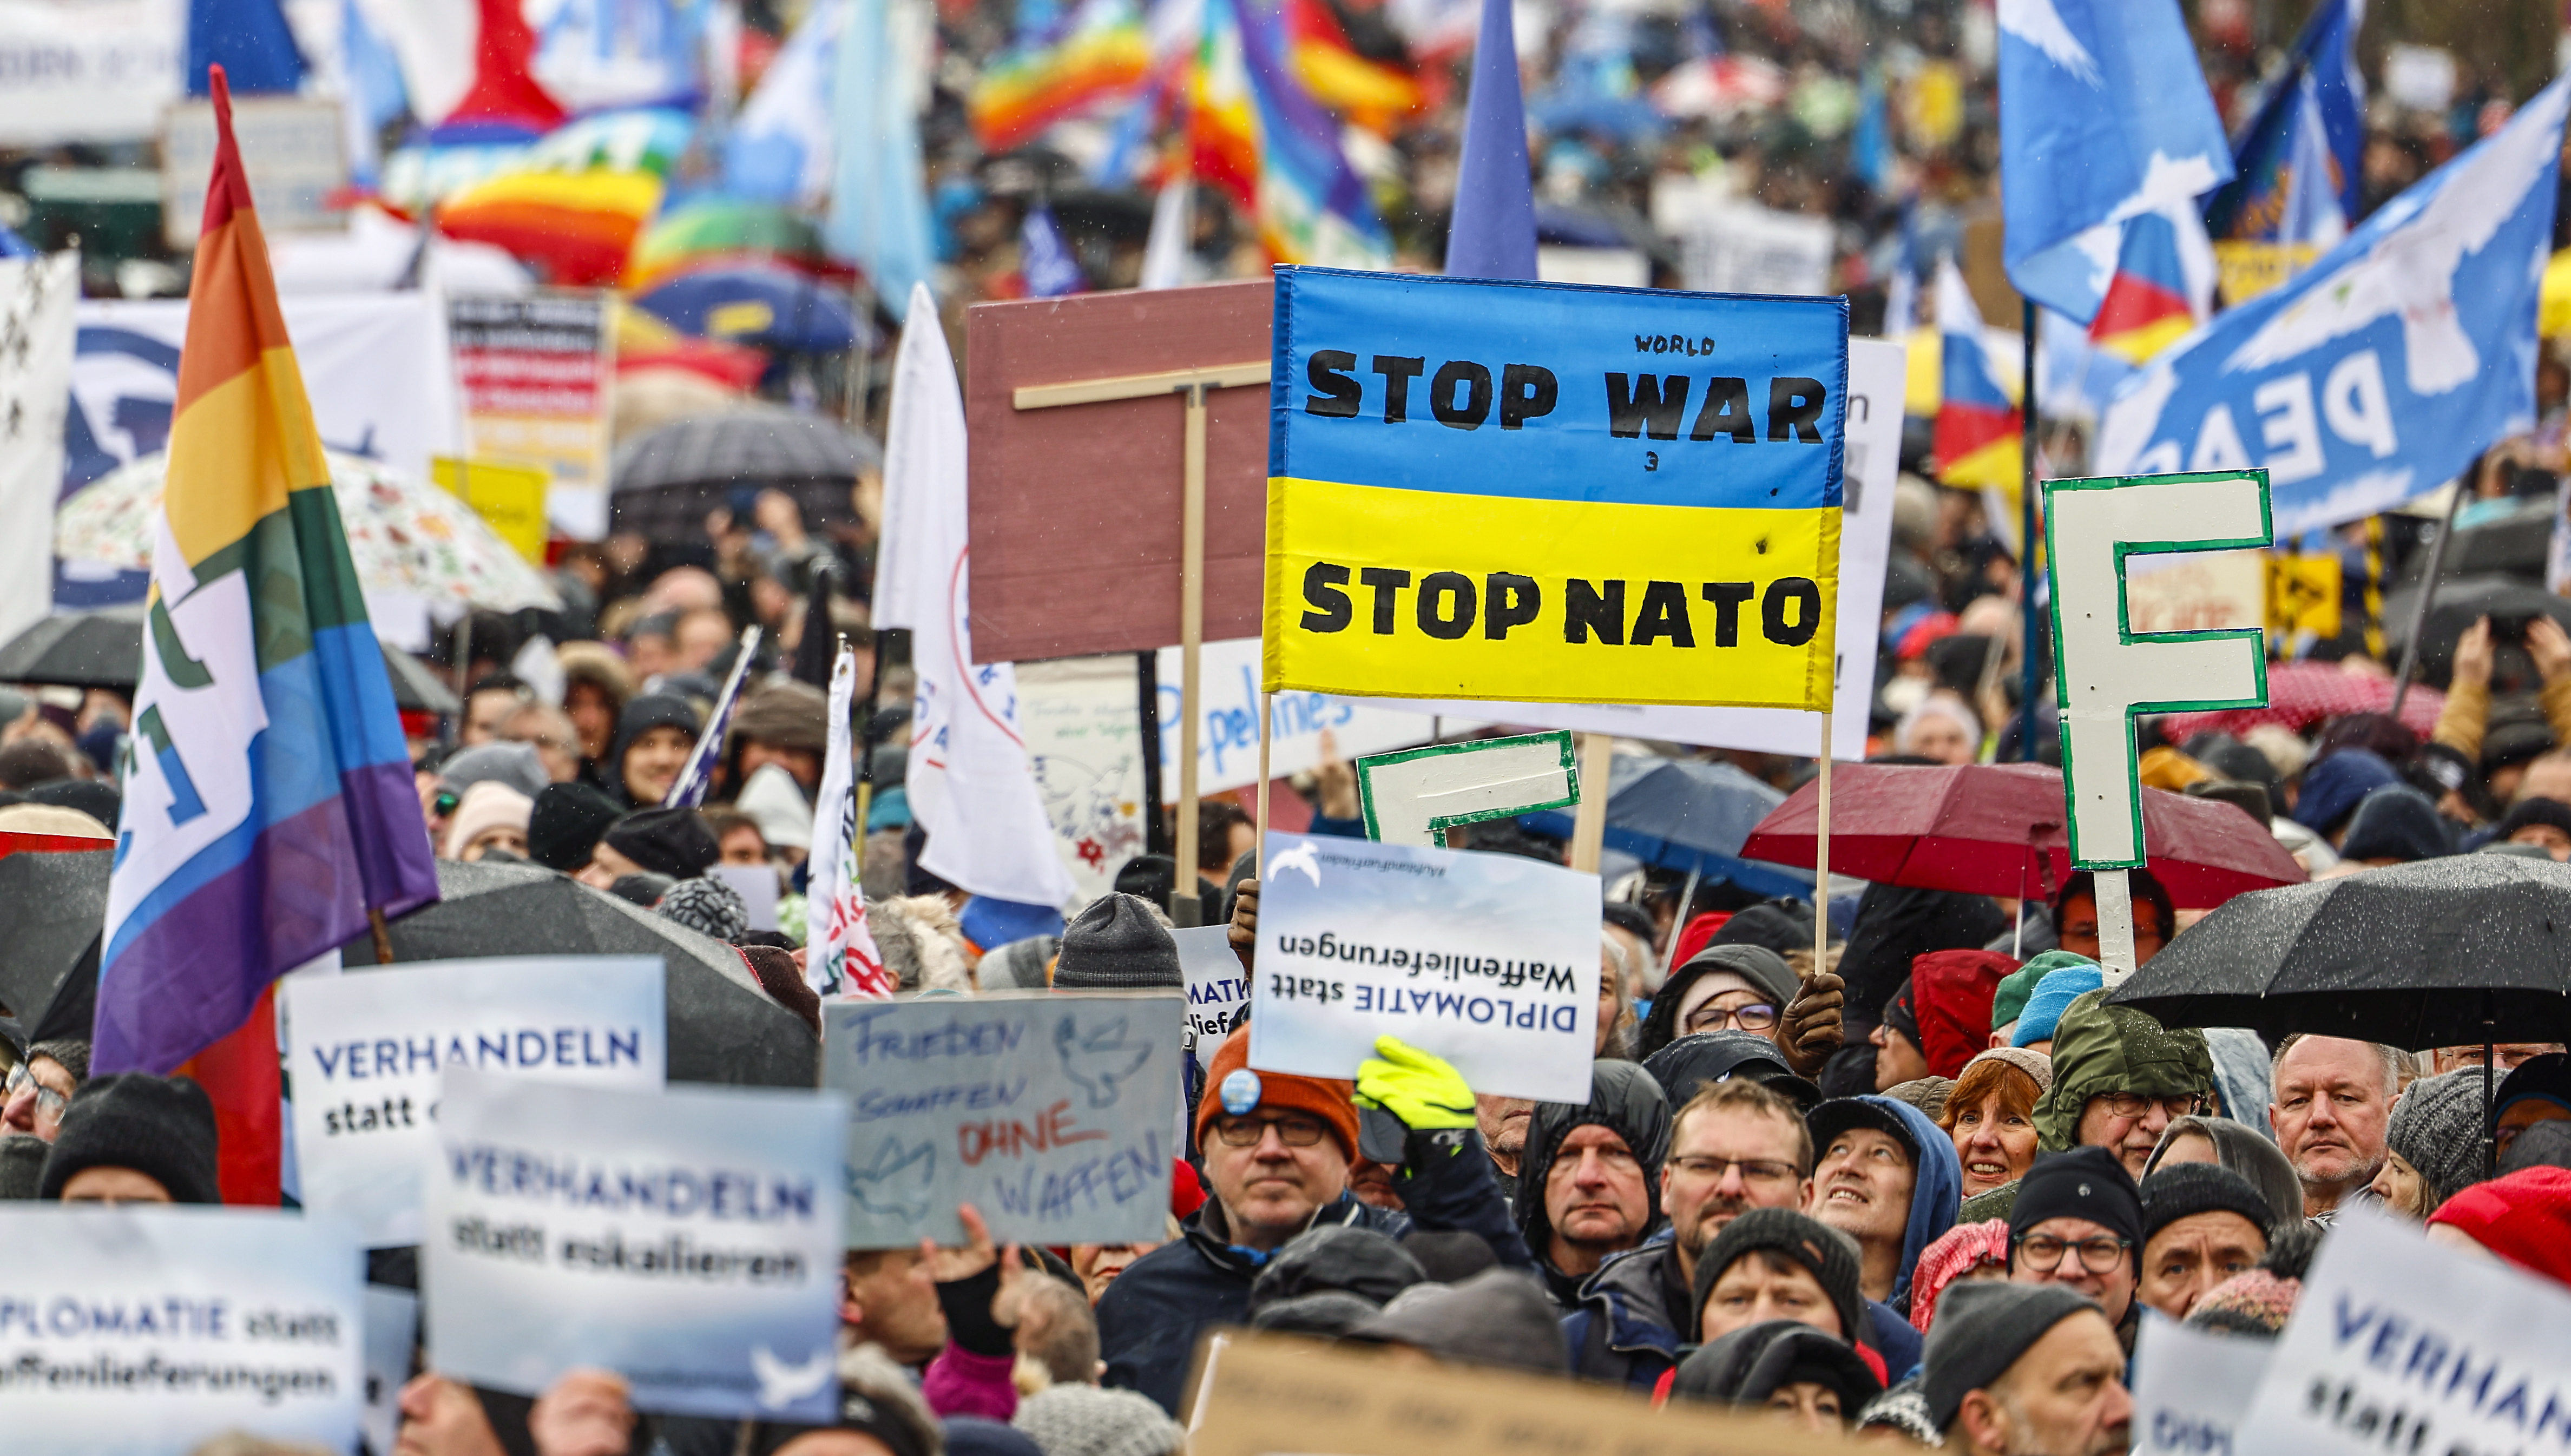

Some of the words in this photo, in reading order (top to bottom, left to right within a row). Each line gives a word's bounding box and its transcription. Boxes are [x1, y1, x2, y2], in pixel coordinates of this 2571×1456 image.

[1635, 334, 1714, 356] WORLD
[1305, 350, 1559, 431] STOP
[1605, 372, 1827, 444] WAR
[1644, 451, 1658, 472] 3
[1299, 561, 1541, 640] STOP
[1564, 576, 1822, 648] NATO
[1280, 935, 1576, 993] Waffenlieferungen
[1272, 974, 1344, 1004] statt
[1354, 985, 1577, 1033] DIPLOMATIE
[313, 1030, 640, 1079] VERHANDELN
[325, 1096, 415, 1135] statt
[958, 1098, 1110, 1167] OHNE
[452, 1145, 814, 1217] VERHANDELN
[455, 1218, 545, 1261] statt
[563, 1237, 803, 1281] eskalieren
[246, 1310, 338, 1341] statt
